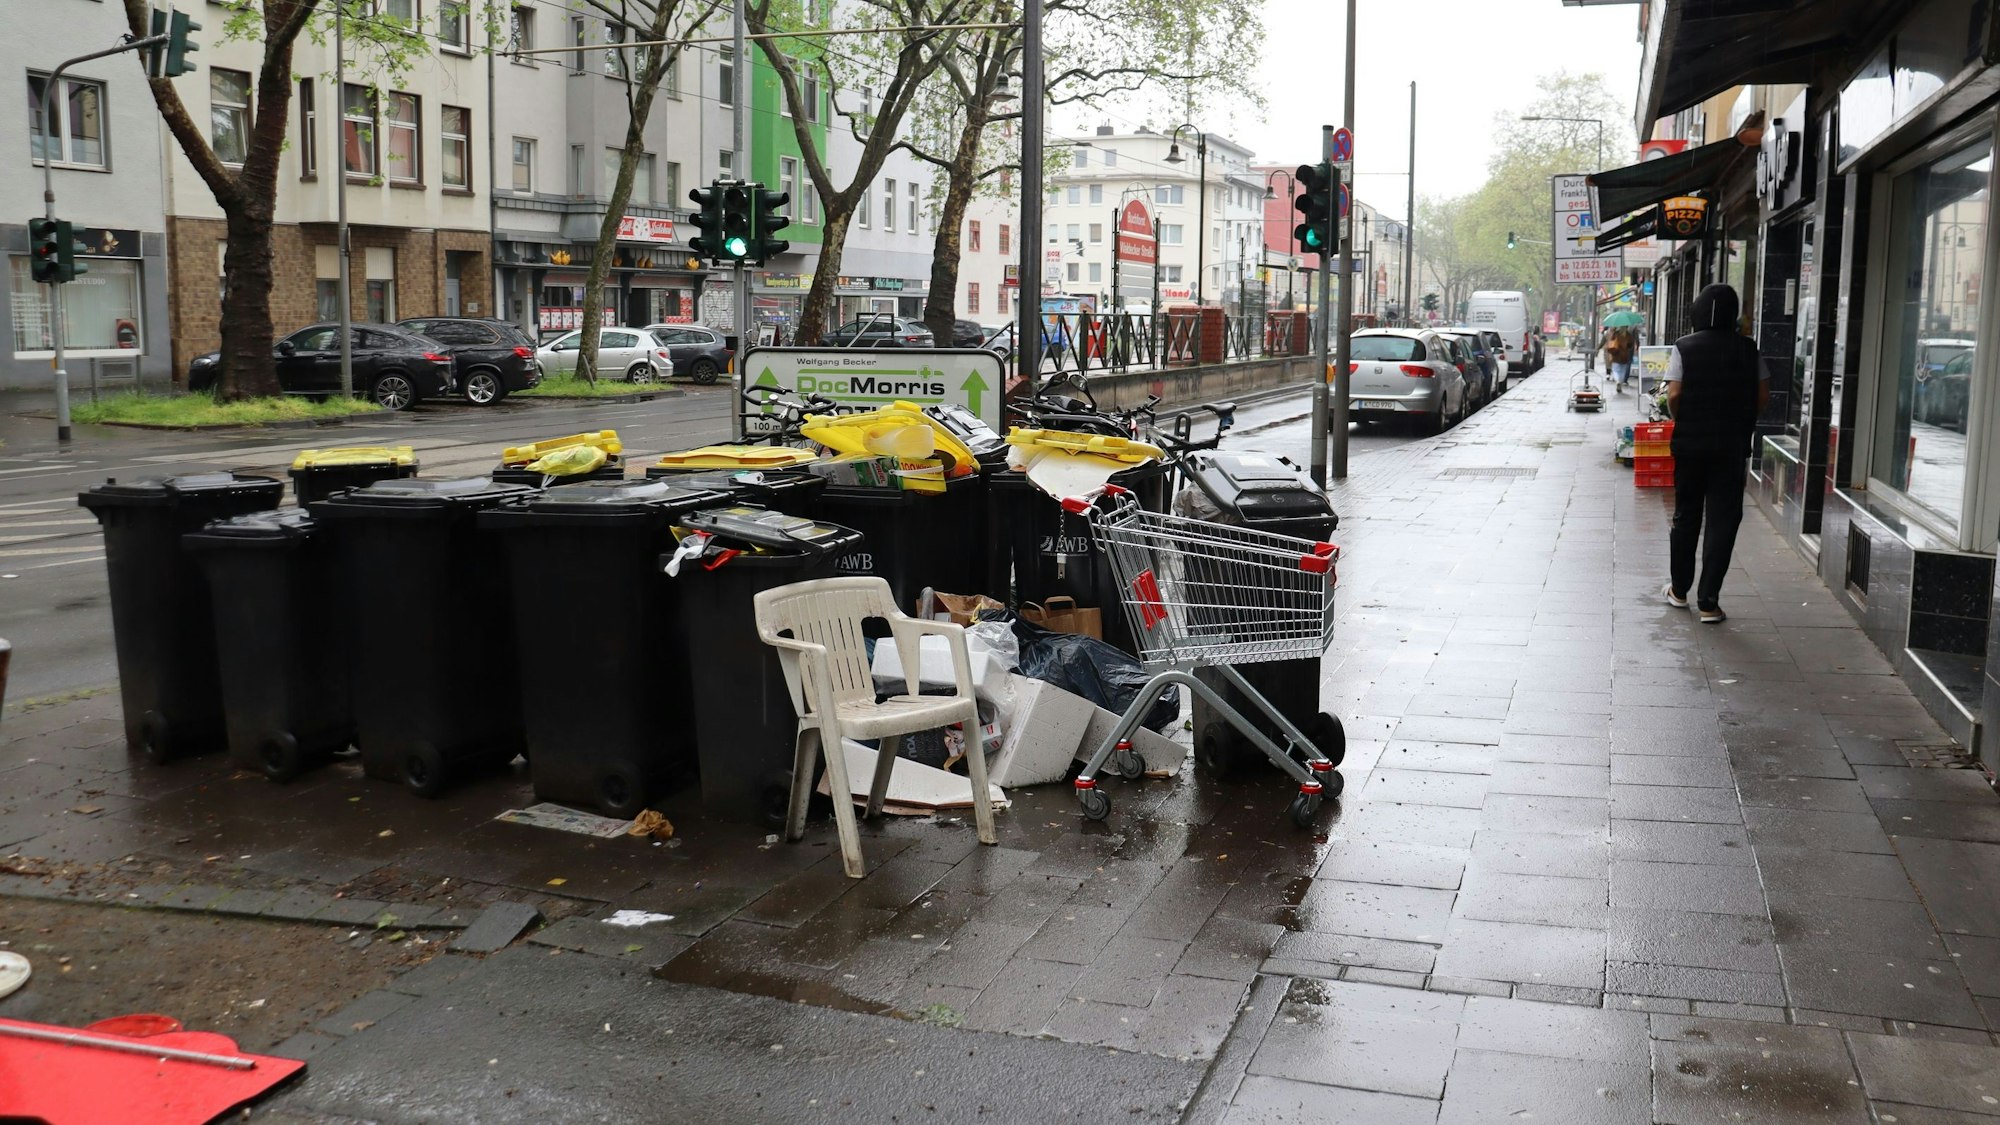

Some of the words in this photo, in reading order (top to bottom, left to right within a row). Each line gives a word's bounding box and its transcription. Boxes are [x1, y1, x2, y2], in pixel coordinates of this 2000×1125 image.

[1563, 179, 1585, 188] Durc
[1560, 190, 1588, 198] Frankfu
[1568, 200, 1590, 209] gesp
[1127, 211, 1146, 226] Buchforst
[1666, 210, 1702, 220] PIZZA
[1141, 245, 1155, 258] Straße
[1571, 248, 1595, 256] Umleitu
[1560, 261, 1569, 270] ab
[1559, 271, 1569, 280] bis
[1604, 269, 1619, 279] 22h
[796, 358, 840, 367] Wolfgang
[842, 358, 877, 366] Becker
[797, 376, 945, 395] DocMorris
[753, 422, 770, 431] 100
[1054, 536, 1088, 553] AWB
[840, 553, 873, 570] AWB
